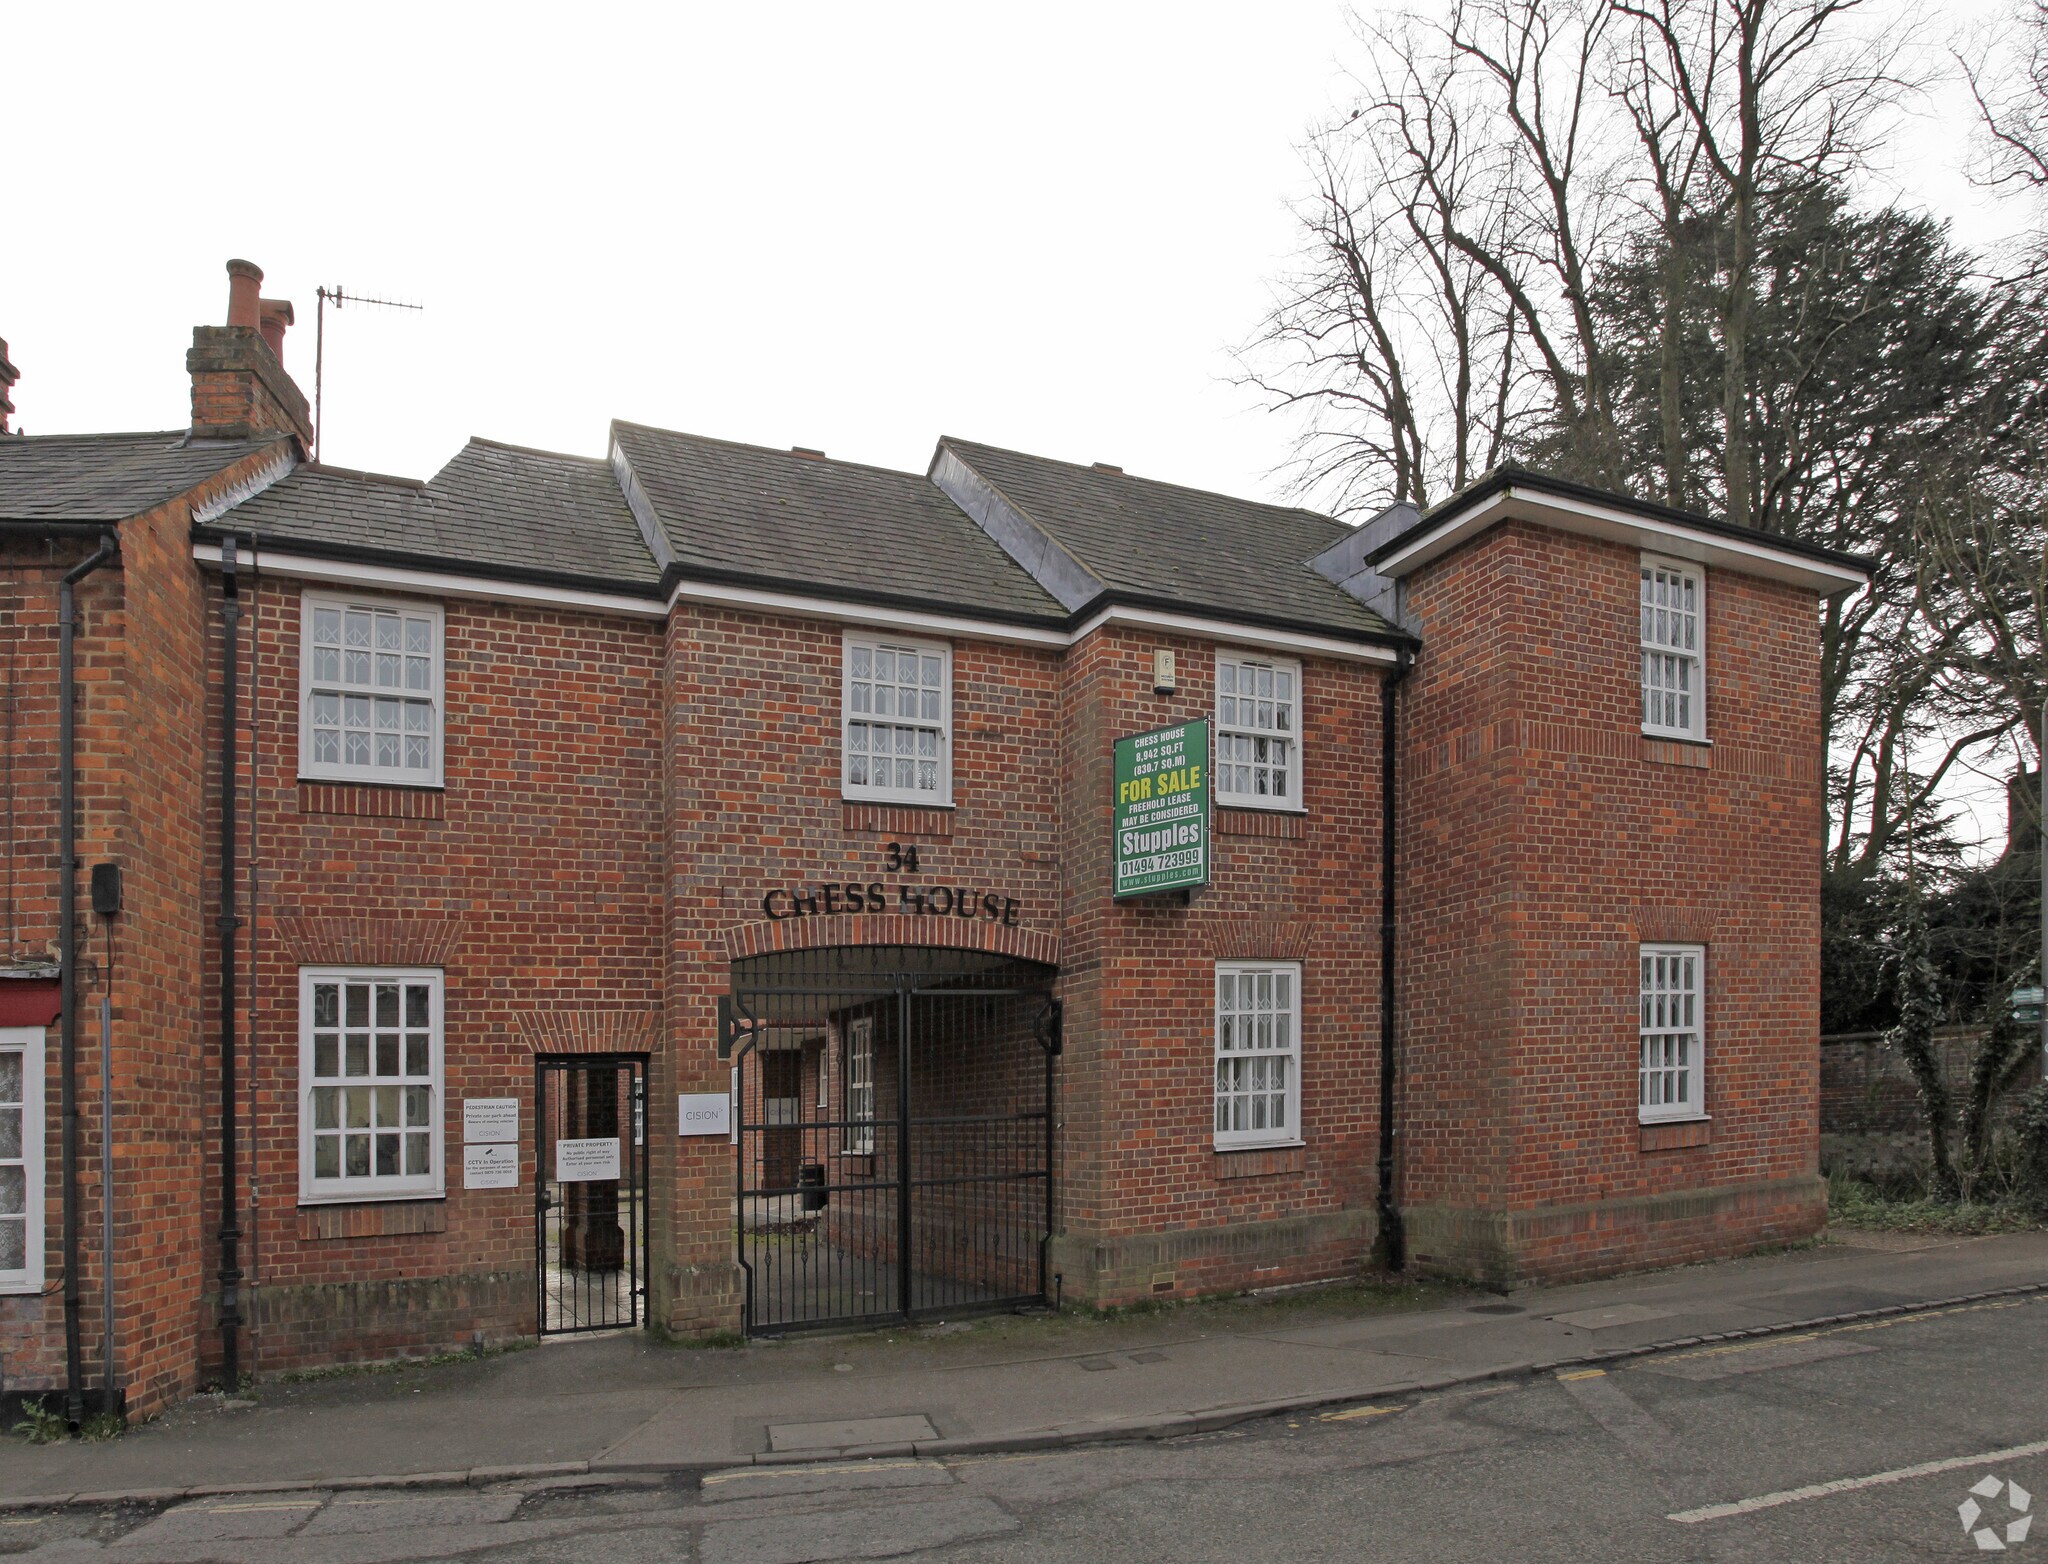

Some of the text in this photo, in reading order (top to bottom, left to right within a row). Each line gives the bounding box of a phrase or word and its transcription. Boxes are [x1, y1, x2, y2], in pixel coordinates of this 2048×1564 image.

[1134, 728, 1185, 748] CHESS HOUSE
[1136, 742, 1184, 763] 8,942 SQ.FT
[1134, 755, 1186, 777] (830.7 SQ.M)
[1120, 766, 1201, 804] FOR SALE
[1129, 792, 1191, 814] FREEHOLD LEASE
[1122, 804, 1198, 828] MAY BE CONSIDERED
[1122, 823, 1199, 856] Stupples
[886, 842, 920, 872] 34
[1122, 850, 1199, 876] 01494 723999
[1122, 866, 1199, 887] www.stupples.com
[763, 882, 1022, 927] CHESS HOUSE
[686, 1111, 718, 1120] CISION
